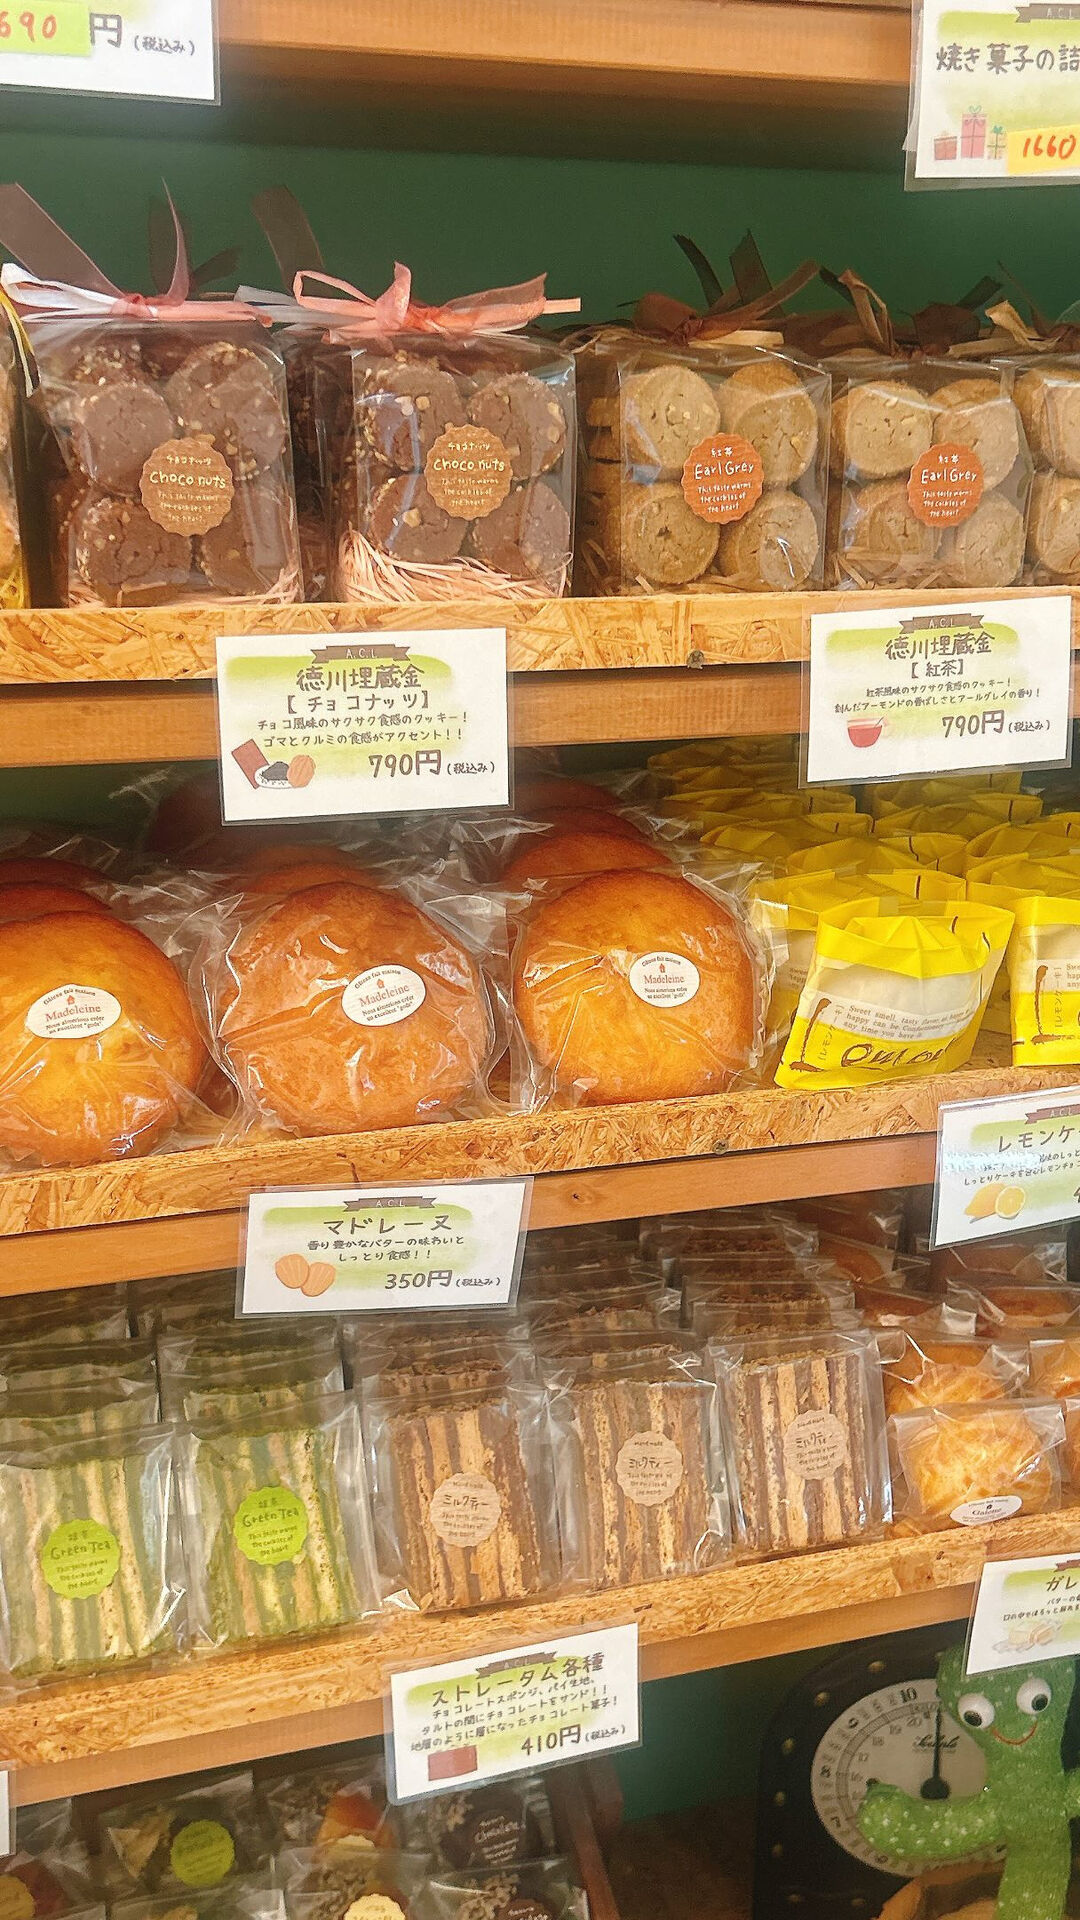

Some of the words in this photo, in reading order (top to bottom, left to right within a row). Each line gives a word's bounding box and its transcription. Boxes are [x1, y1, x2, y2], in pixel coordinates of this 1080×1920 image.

[134, 35, 195, 56] (税込み)
[1023, 134, 1077, 160] 1660
[434, 458, 474, 471] Choco
[479, 458, 505, 472] nuts
[695, 462, 722, 480] Earl
[725, 461, 754, 475] Grey
[150, 471, 193, 486] Choco
[198, 475, 226, 489] nuts
[921, 468, 947, 484] Earl
[950, 468, 977, 482] Grey
[885, 631, 995, 661] 徳川埋蔵金
[296, 664, 425, 693] 徳川埋蔵金
[644, 975, 685, 984] Madeleine
[359, 984, 410, 1008] Madeleine
[45, 1004, 102, 1022] Madeleine
[998, 1125, 1080, 1153] レモンケ
[323, 1214, 452, 1235] マドレーヌ
[307, 1235, 465, 1251] 香り豊かなバターの味わいと
[242, 1512, 277, 1527] Green
[278, 1507, 299, 1519] Tea
[51, 1544, 87, 1560] Green
[88, 1540, 111, 1553] Tea
[1046, 1575, 1079, 1591] ガレ
[432, 1651, 605, 1707] ストレータム各種
[900, 1687, 917, 1703] 10
